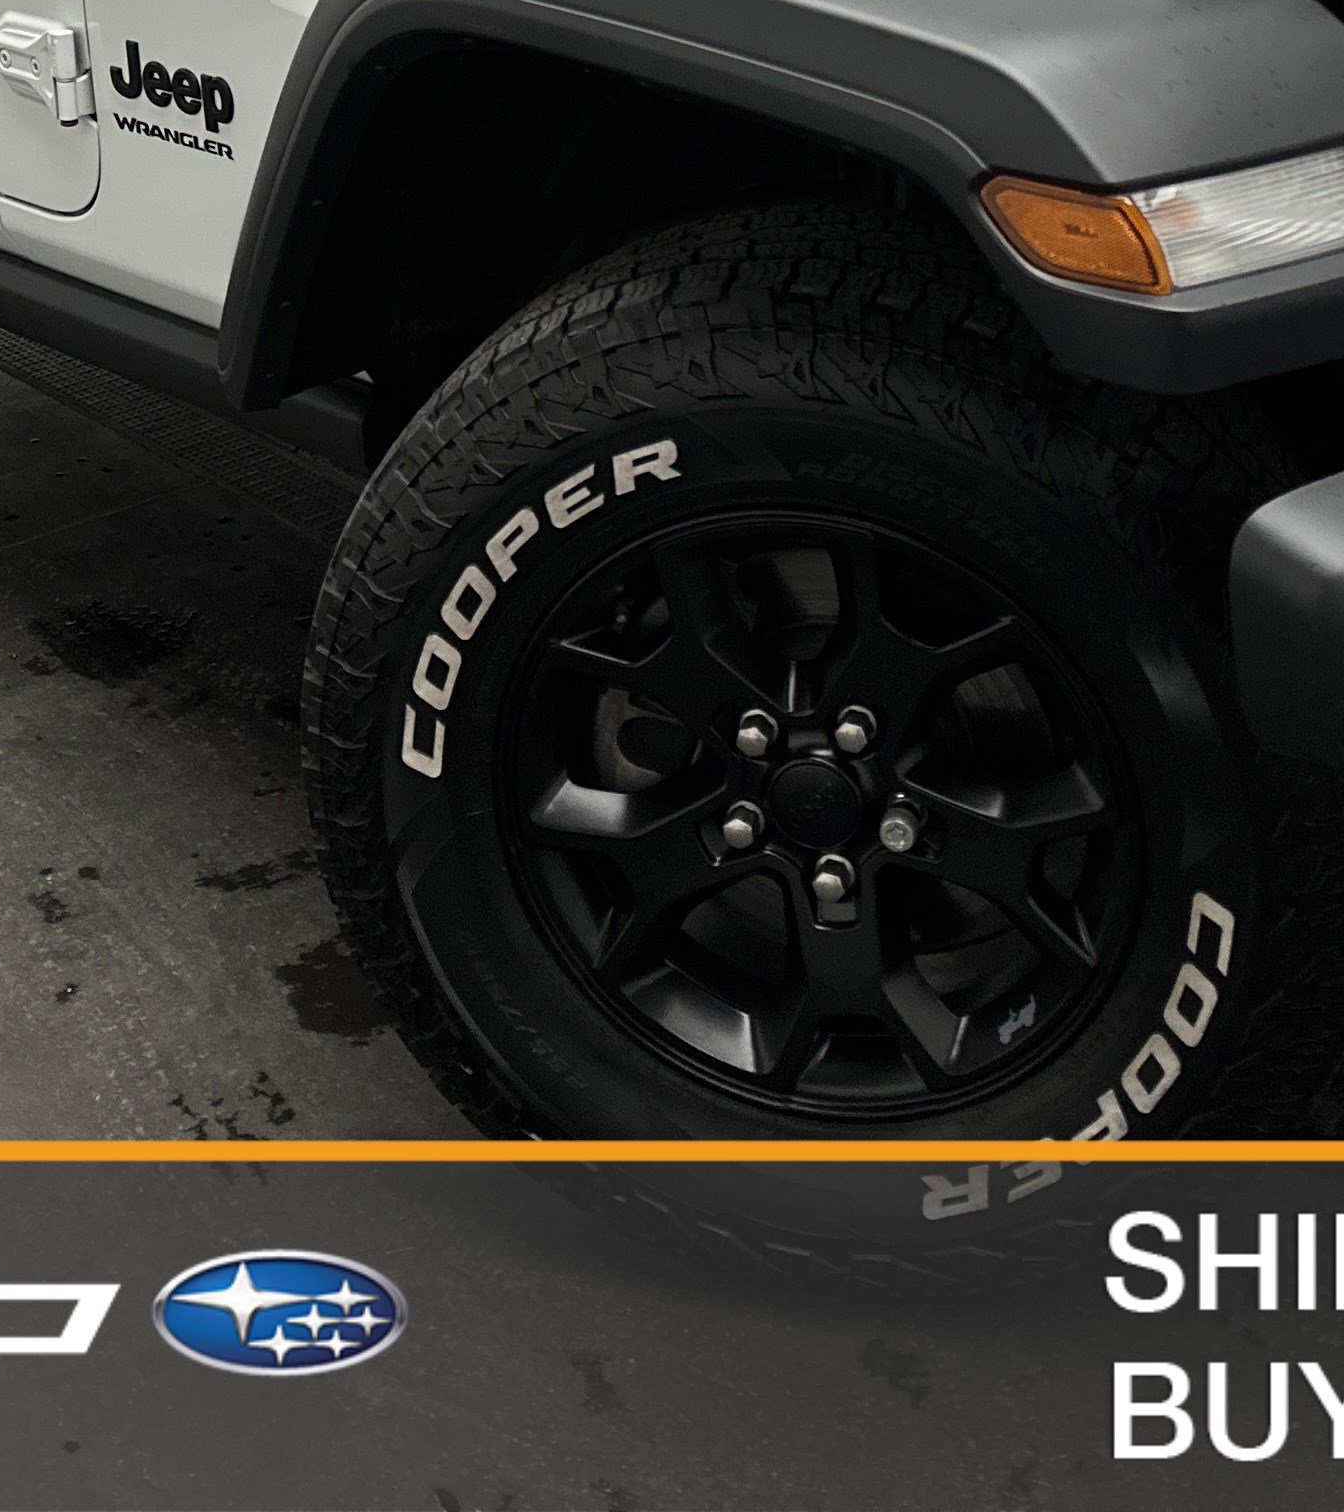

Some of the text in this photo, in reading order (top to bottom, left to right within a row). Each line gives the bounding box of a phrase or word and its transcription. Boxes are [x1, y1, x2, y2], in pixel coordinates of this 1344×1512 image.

[109, 39, 235, 134] Jeep
[112, 112, 235, 161] WRANGLER
[401, 438, 683, 778] COOPER
